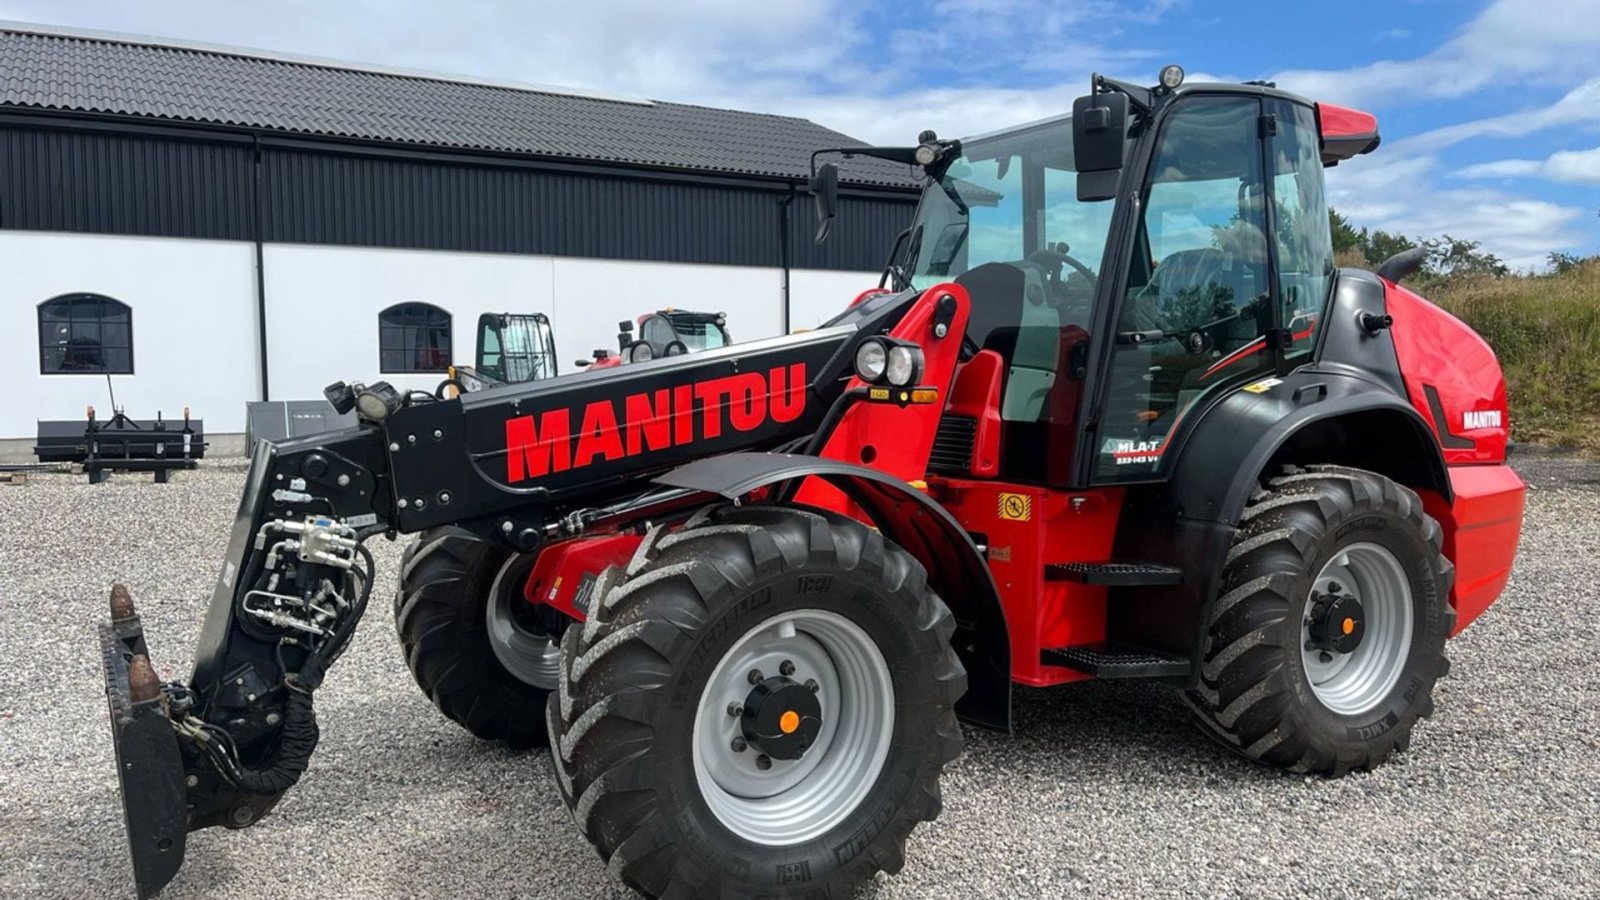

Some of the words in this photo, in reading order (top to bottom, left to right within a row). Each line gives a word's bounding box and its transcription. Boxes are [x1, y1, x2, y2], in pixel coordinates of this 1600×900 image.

[505, 362, 808, 484] MANITOU
[1463, 410, 1502, 430] MANITOU
[1358, 717, 1390, 741] XMCL
